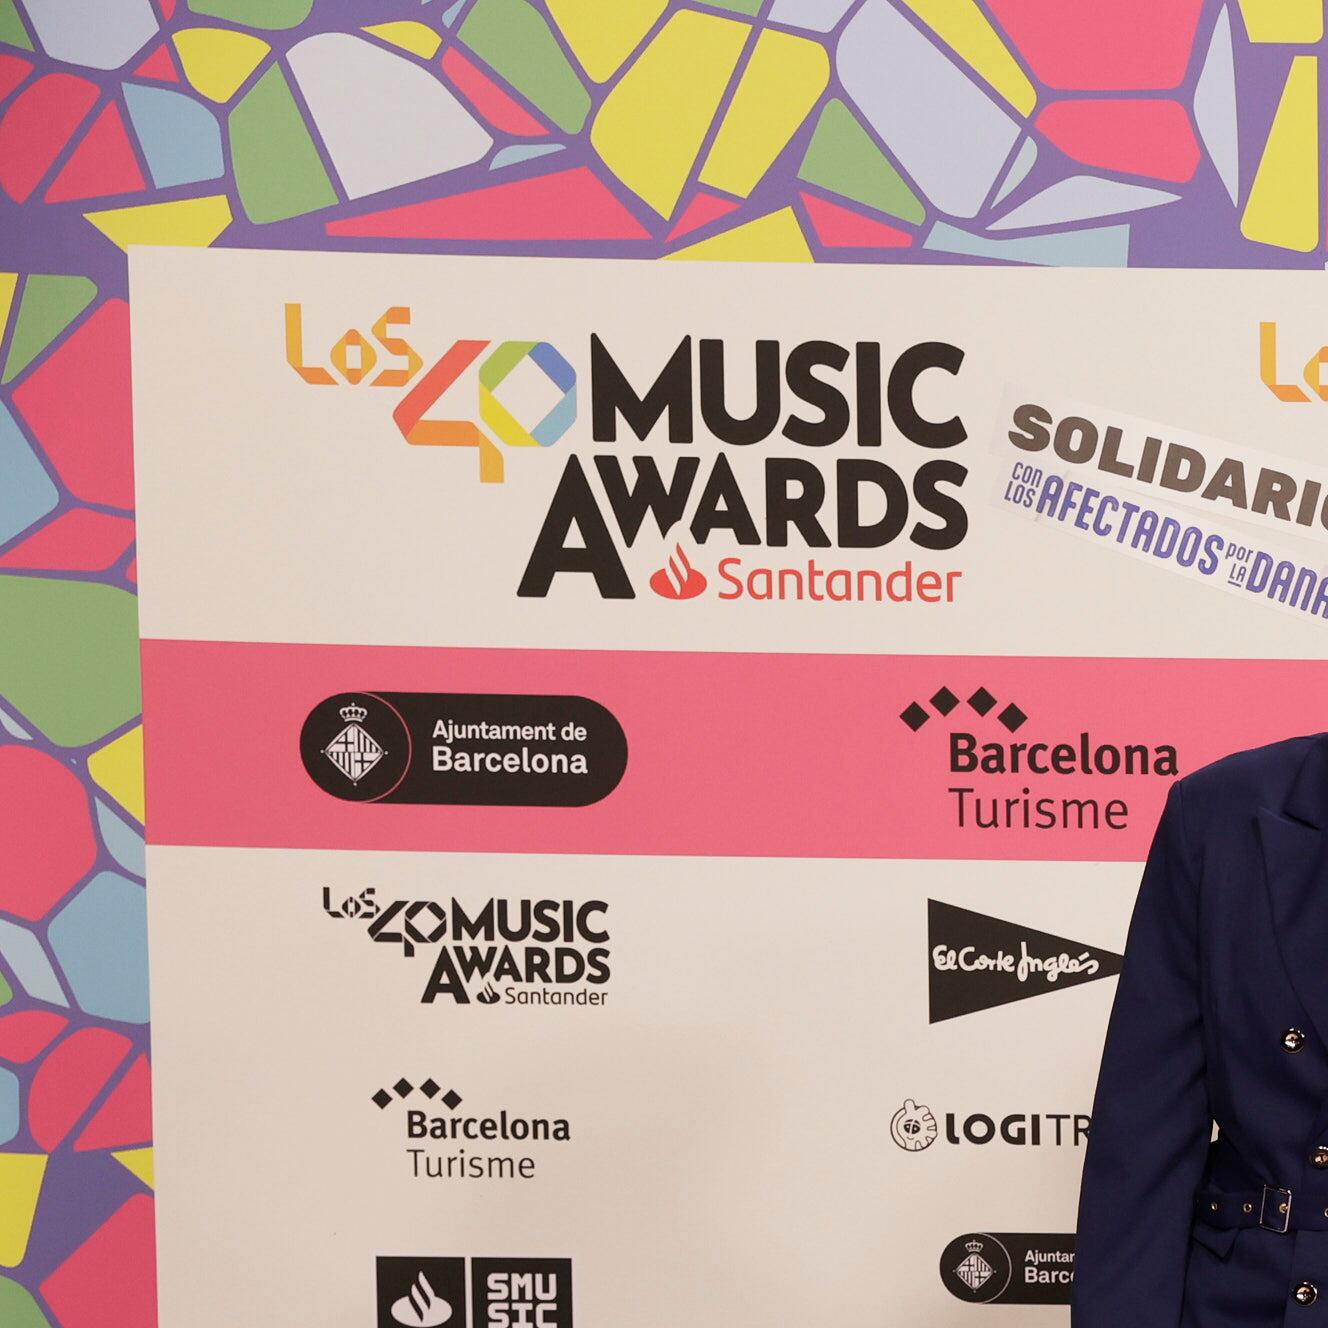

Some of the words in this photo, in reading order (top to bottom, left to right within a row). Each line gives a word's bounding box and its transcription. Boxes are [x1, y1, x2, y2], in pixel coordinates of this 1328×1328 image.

[393, 339, 577, 483] 40
[590, 333, 968, 449] MUSIC
[1012, 462, 1043, 487] CON
[1004, 480, 1036, 509] LOS
[516, 452, 969, 600] AWARDS
[1036, 475, 1224, 575] AFECTADOS
[718, 558, 963, 603] Santander
[1229, 563, 1247, 582] LA
[433, 718, 556, 747] Ajuntament
[561, 721, 587, 742] de
[433, 746, 588, 776] Barcelona
[950, 732, 1179, 776] Barcelona
[948, 787, 1129, 830] Turisme
[451, 896, 610, 943] MUSIC
[420, 944, 611, 1004] AWARDS
[932, 945, 957, 971] El
[958, 946, 1015, 972] Corte
[1017, 941, 1100, 982] Inglés
[505, 987, 608, 1006] Santander
[407, 1110, 571, 1141] Barcelona
[946, 1113, 1092, 1146] LOGITR
[406, 1149, 536, 1179] Turisme
[487, 1272, 557, 1300] SMU
